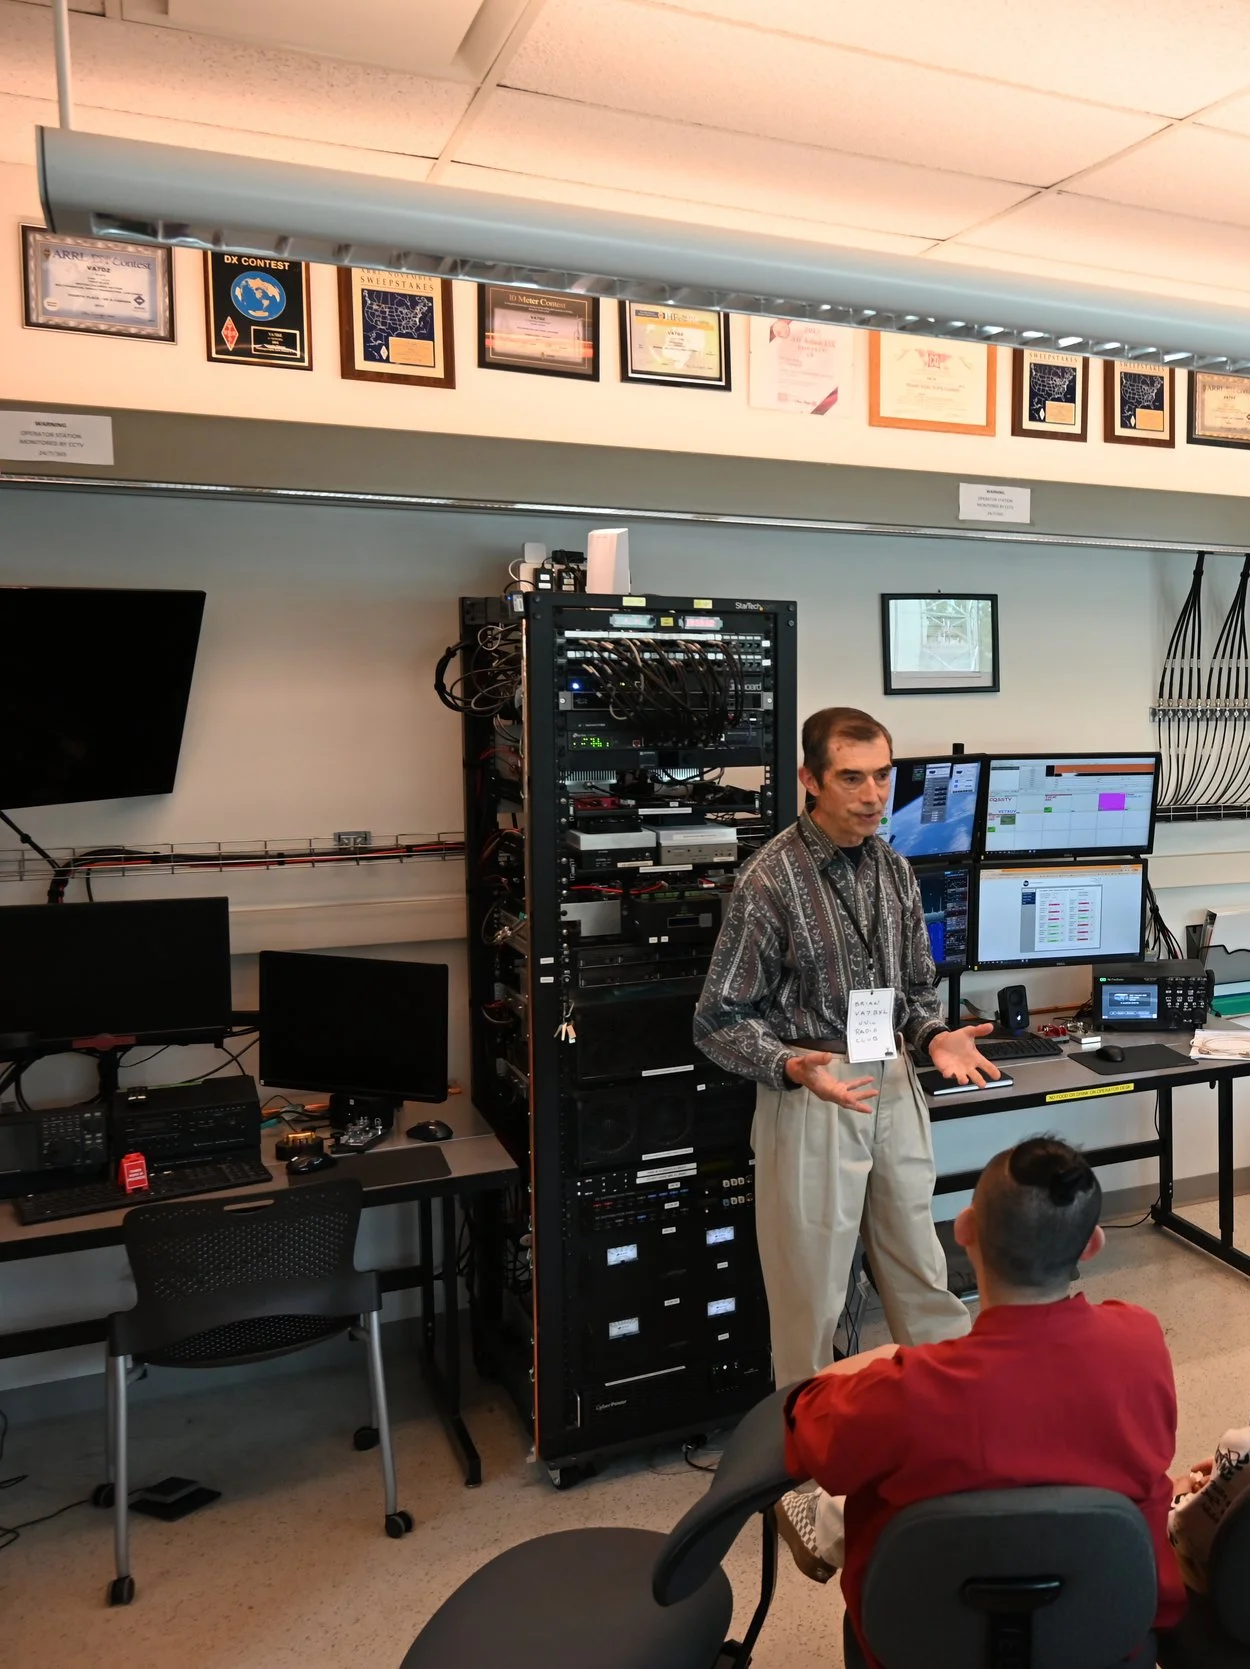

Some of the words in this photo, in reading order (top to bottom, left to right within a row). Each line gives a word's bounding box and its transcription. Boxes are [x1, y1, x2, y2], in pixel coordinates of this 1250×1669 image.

[112, 257, 152, 271] Contest
[224, 255, 239, 264] DX
[241, 257, 290, 270] CONTEST
[360, 275, 434, 291] SWEEPSTAKES
[518, 295, 540, 305] Meter
[540, 298, 567, 308] Contest
[1029, 352, 1078, 363] SWEEPSTAKES
[1120, 361, 1165, 372] SWEEPSTAKES
[1097, 1086, 1119, 1094] OPERATOR
